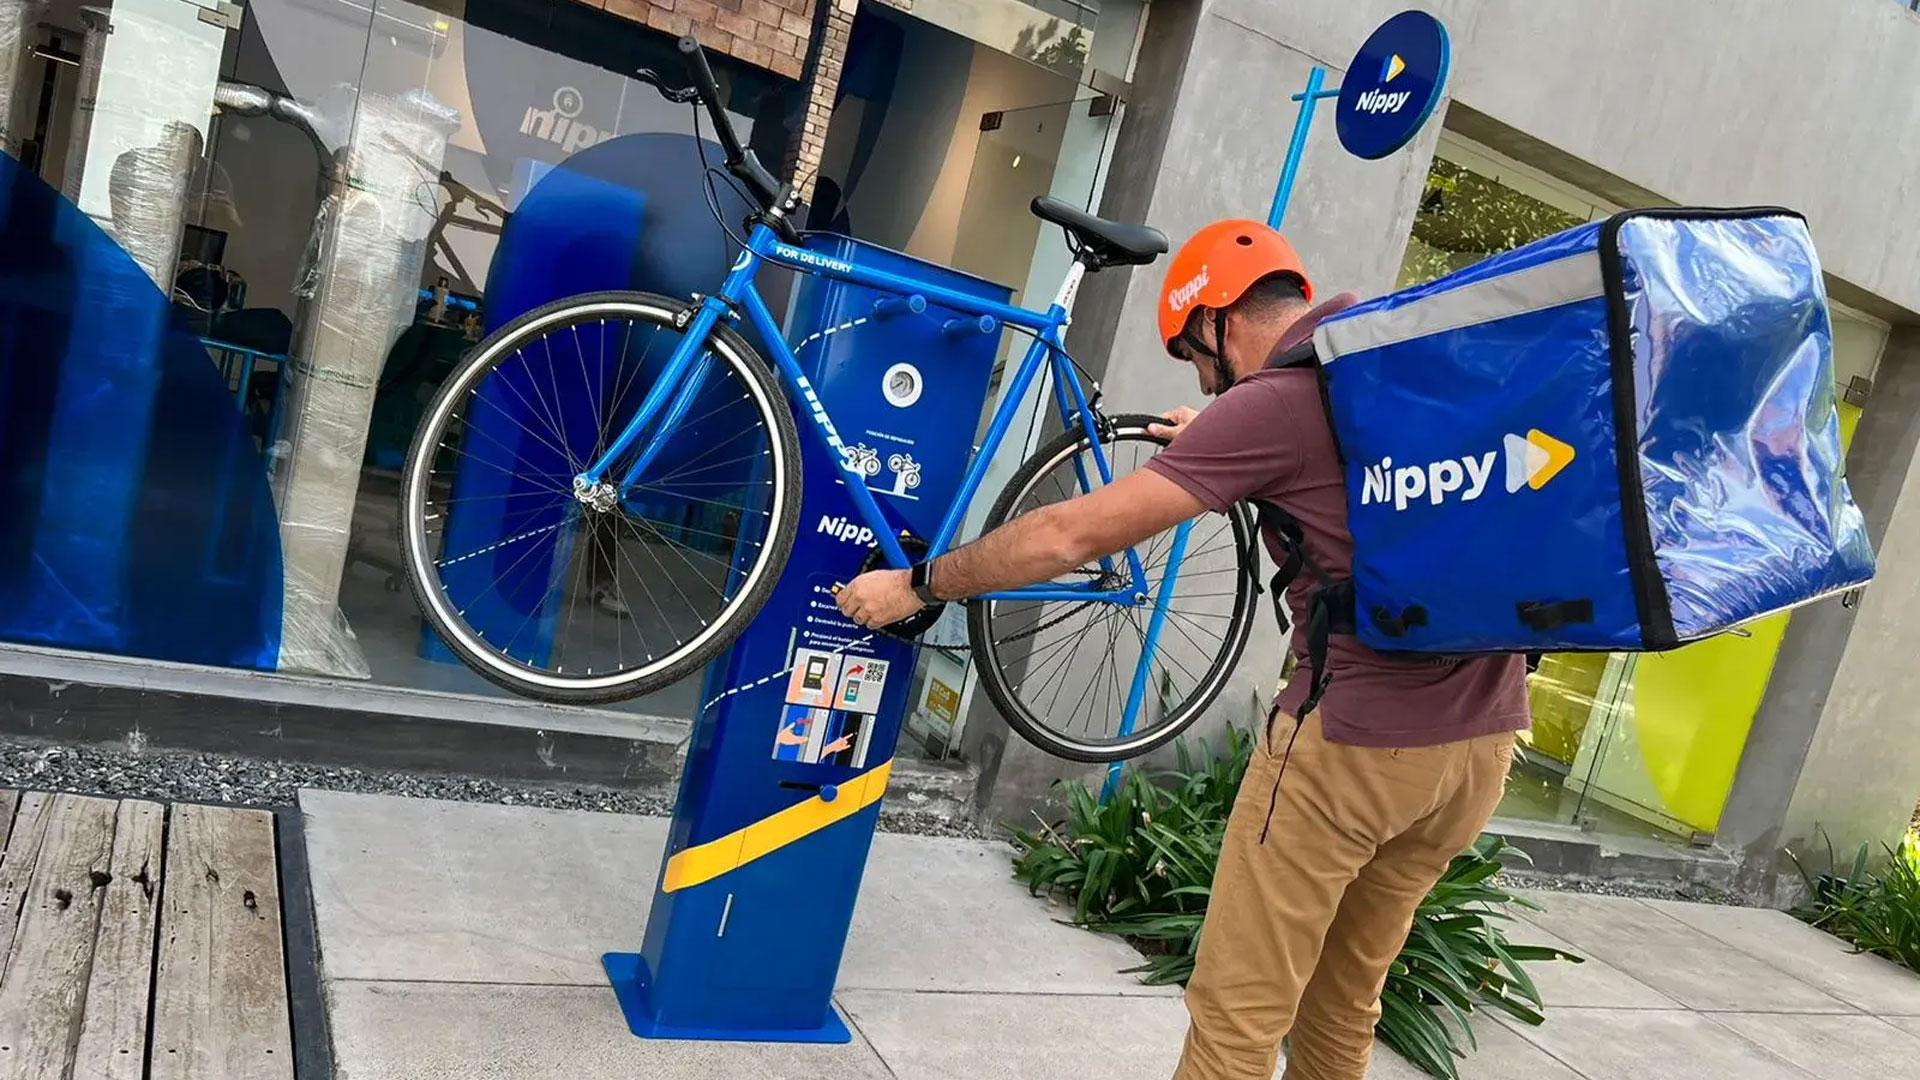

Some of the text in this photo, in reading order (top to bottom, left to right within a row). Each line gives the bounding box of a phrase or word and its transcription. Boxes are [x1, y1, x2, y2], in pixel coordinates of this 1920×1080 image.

[1354, 88, 1411, 114] Nippy
[776, 245, 852, 273] FOR DELIVERY
[1168, 264, 1209, 312] Rappi
[1361, 450, 1497, 511] Nippy
